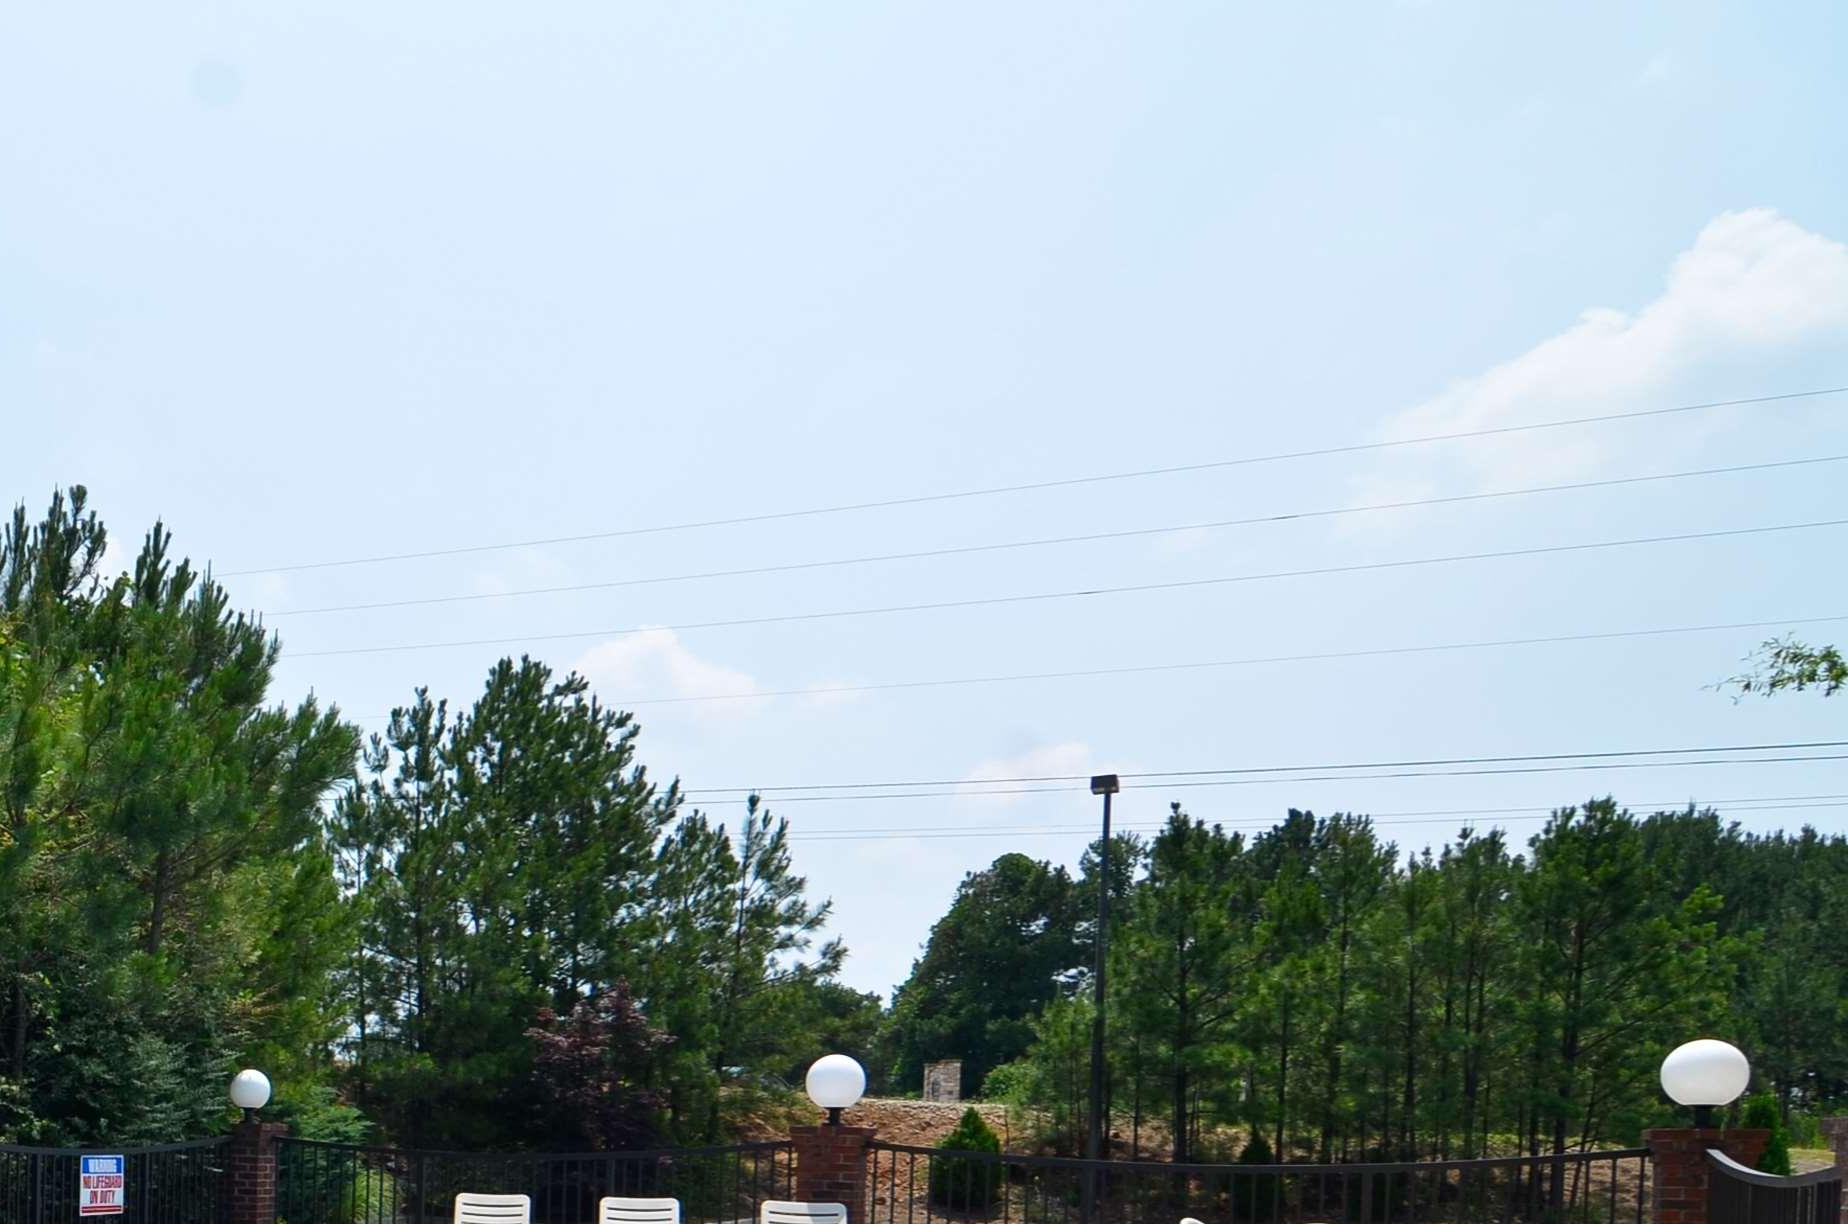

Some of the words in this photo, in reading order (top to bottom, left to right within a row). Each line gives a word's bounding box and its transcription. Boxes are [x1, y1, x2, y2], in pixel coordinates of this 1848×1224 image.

[83, 1175, 92, 1189] NO
[92, 1174, 122, 1189] LIFEGUARD
[89, 1190, 99, 1204] ON
[99, 1189, 116, 1204] DUTY
